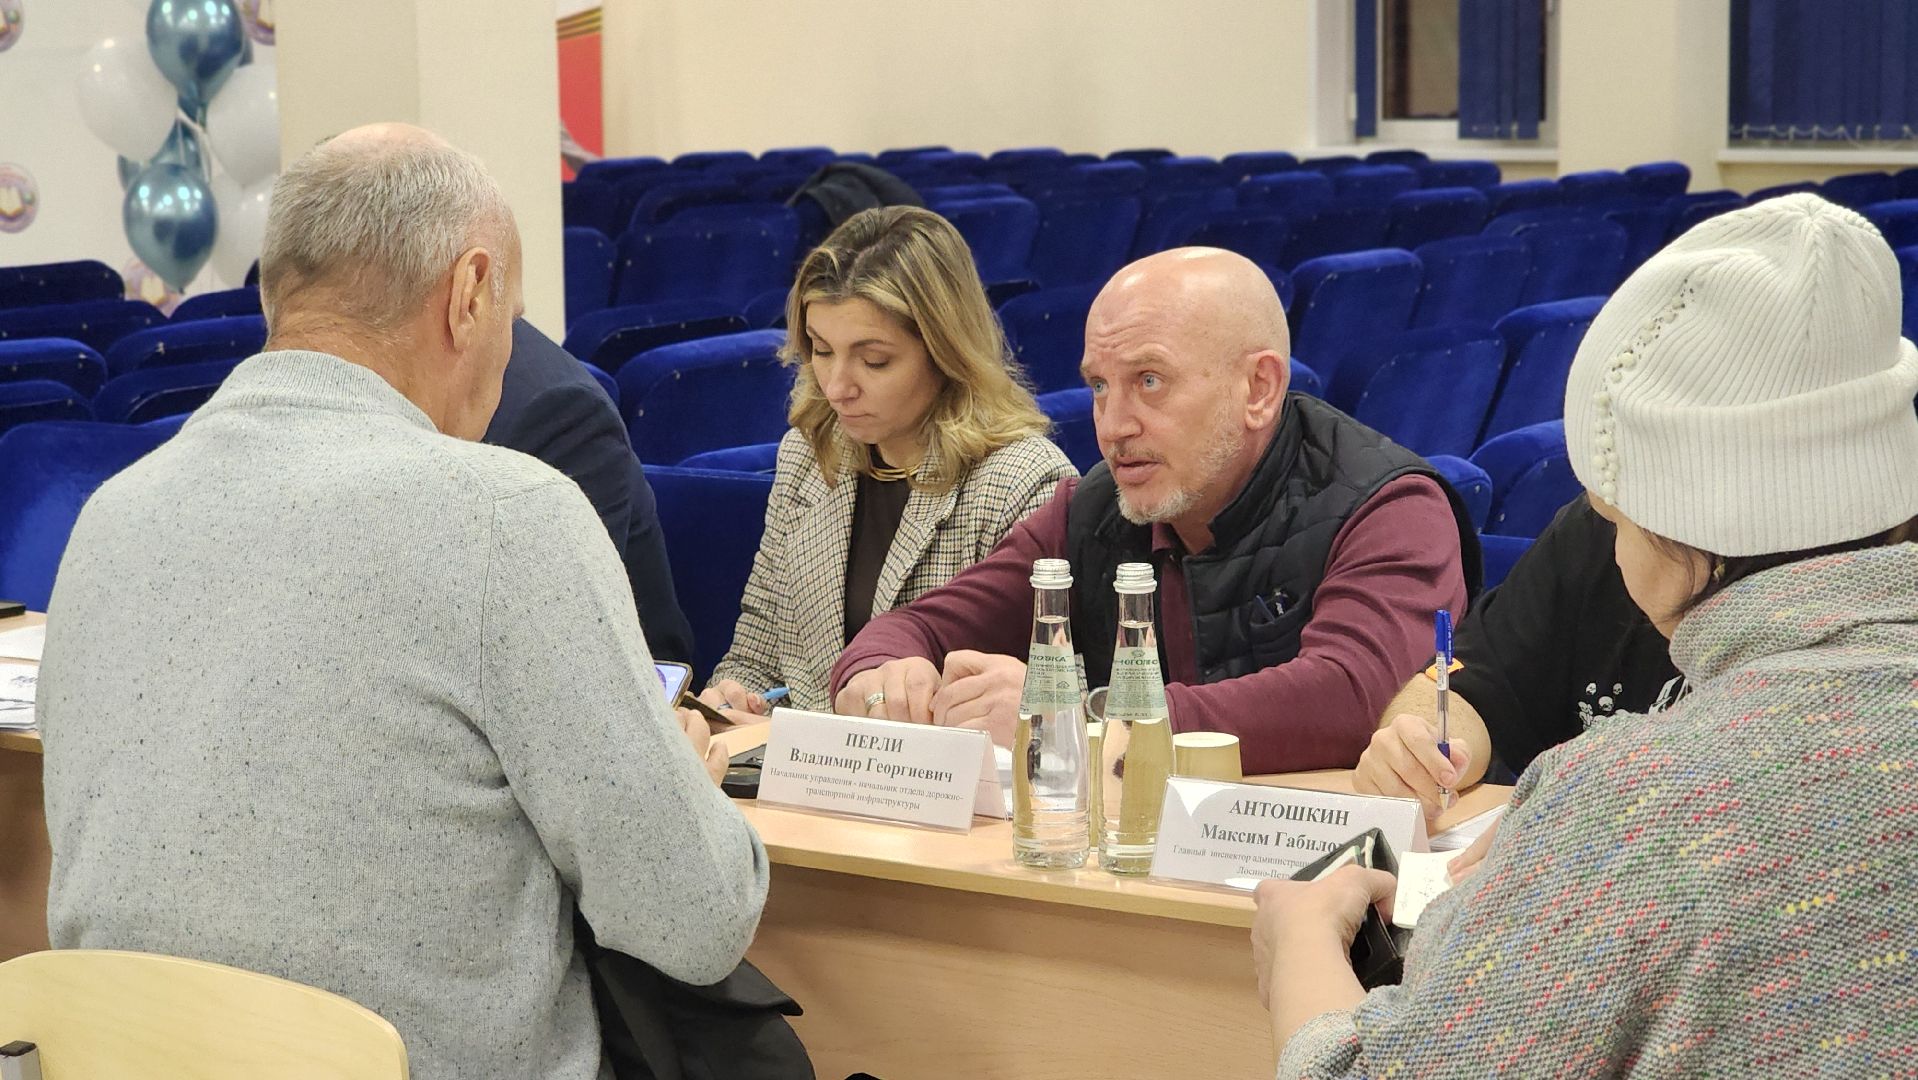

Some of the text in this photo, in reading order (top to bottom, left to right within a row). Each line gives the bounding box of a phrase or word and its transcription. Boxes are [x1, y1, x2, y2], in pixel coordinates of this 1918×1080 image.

[845, 732, 905, 753] ПЕРЛИ
[789, 747, 953, 783] Владимир Георгиевич
[770, 767, 809, 780] Начальник
[809, 774, 852, 787] управления
[858, 781, 899, 793] начальник
[899, 786, 925, 797] отдела
[925, 791, 964, 802] дорожно-
[805, 787, 920, 810] транспортной инфраструктуры
[1229, 799, 1350, 826] АНТОШКИН
[1200, 823, 1270, 846] Максим
[1173, 844, 1207, 857] Главный
[1210, 851, 1252, 863] инспектор
